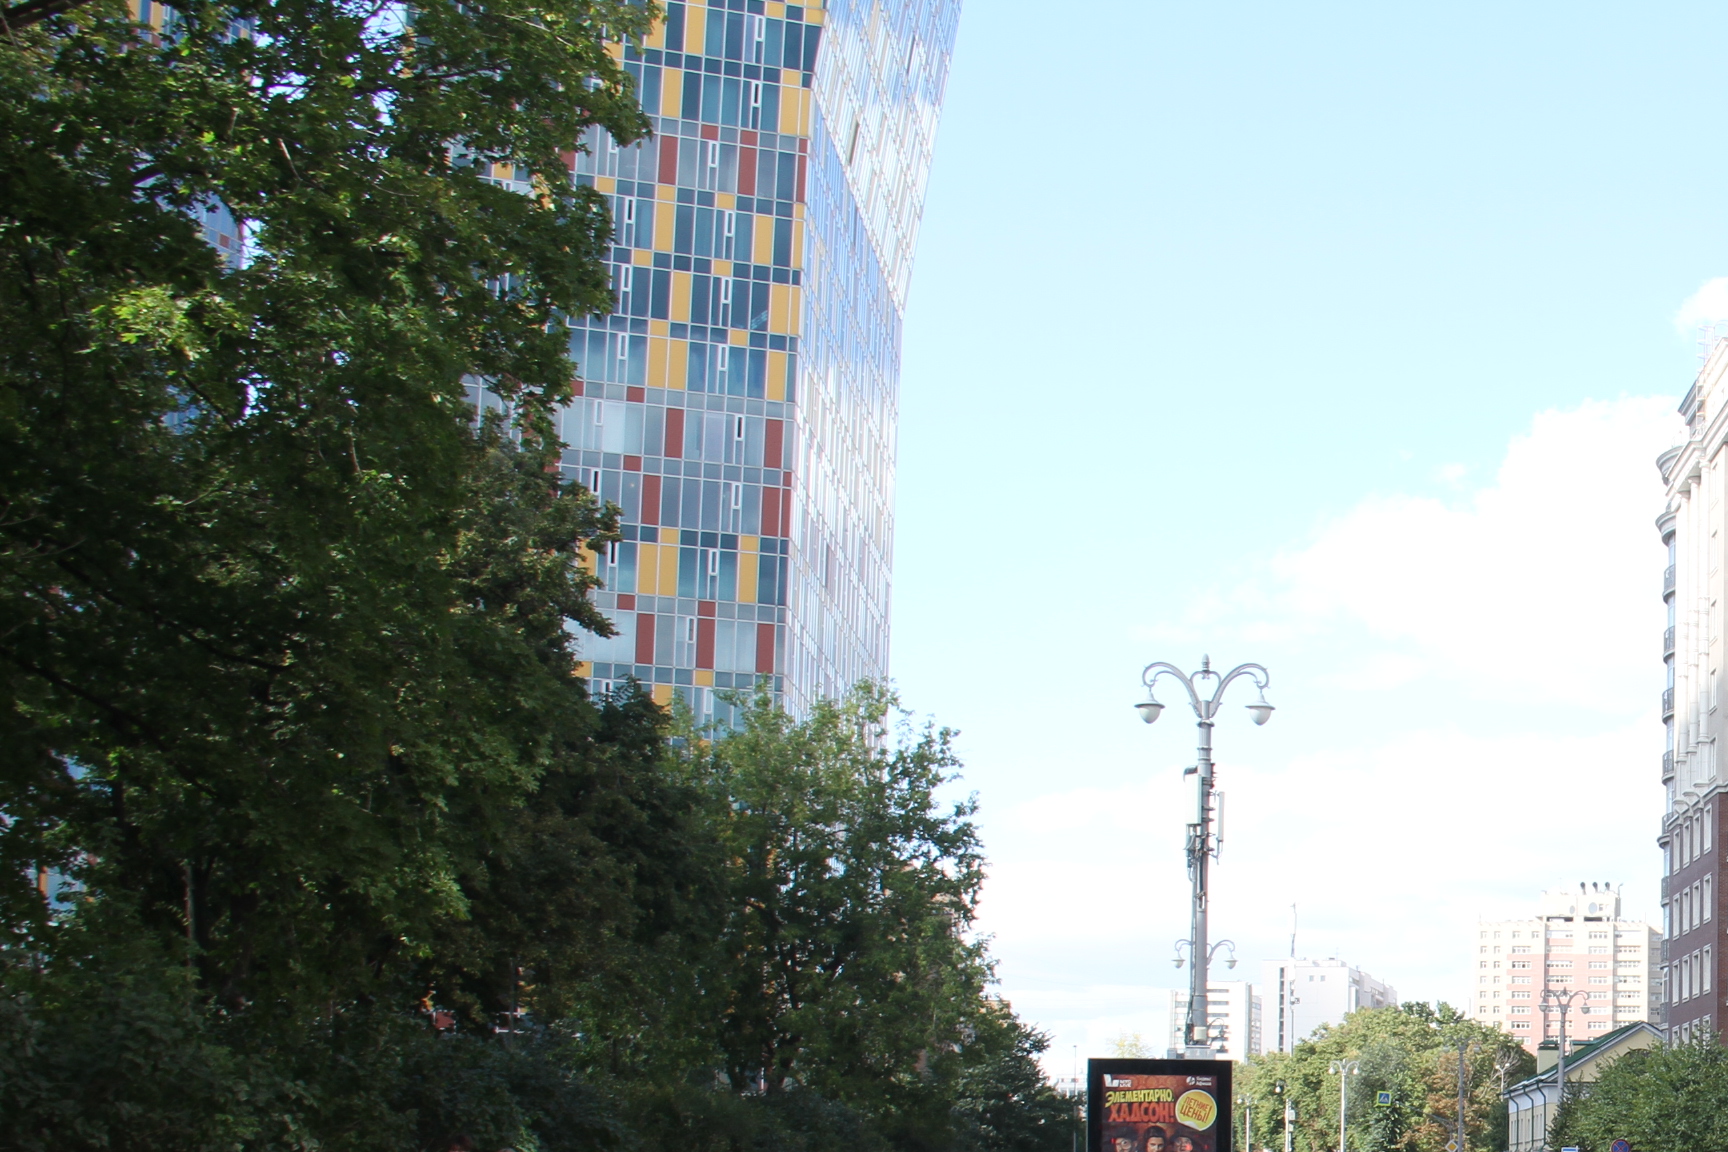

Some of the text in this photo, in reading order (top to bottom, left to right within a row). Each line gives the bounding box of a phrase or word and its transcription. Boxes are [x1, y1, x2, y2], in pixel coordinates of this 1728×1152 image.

[1104, 1089, 1175, 1108] ЭЛЕМЕНТАРНО.
[1185, 1096, 1210, 1111] ЛЕТНИЕ
[1108, 1102, 1175, 1122] ХАДСОН!
[1180, 1104, 1213, 1123] ЦЕНЫ!
